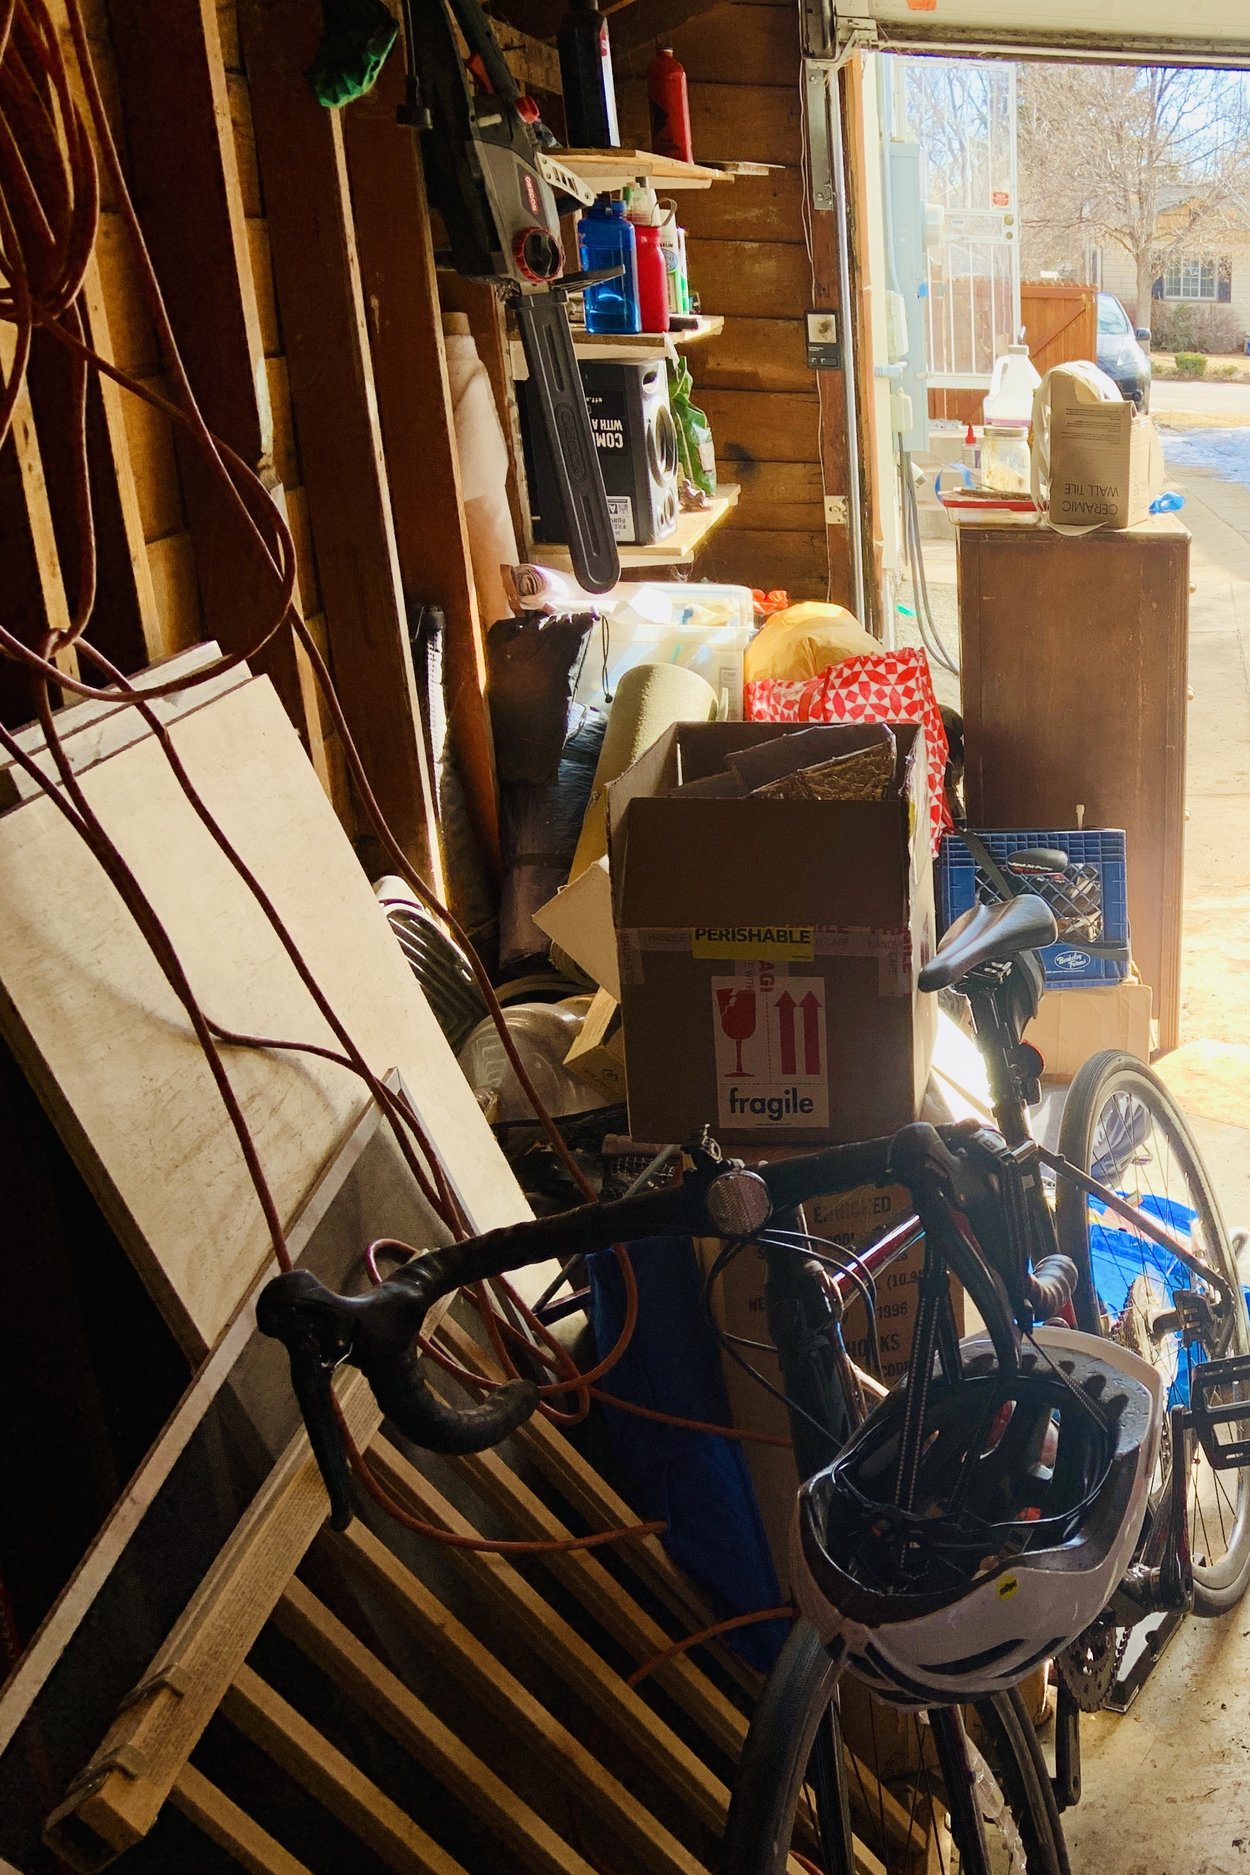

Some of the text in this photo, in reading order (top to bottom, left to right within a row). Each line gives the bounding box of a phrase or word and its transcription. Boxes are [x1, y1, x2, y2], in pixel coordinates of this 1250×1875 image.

[523, 174, 537, 212] OREGON
[591, 418, 623, 431] WITH A
[594, 432, 624, 448] COM
[1064, 483, 1119, 497] WALL TILE
[1061, 500, 1118, 516] CERAMIC
[694, 927, 812, 944] PERISHABLE
[728, 1087, 814, 1121] fragile
[875, 1302, 908, 1321] 1996
